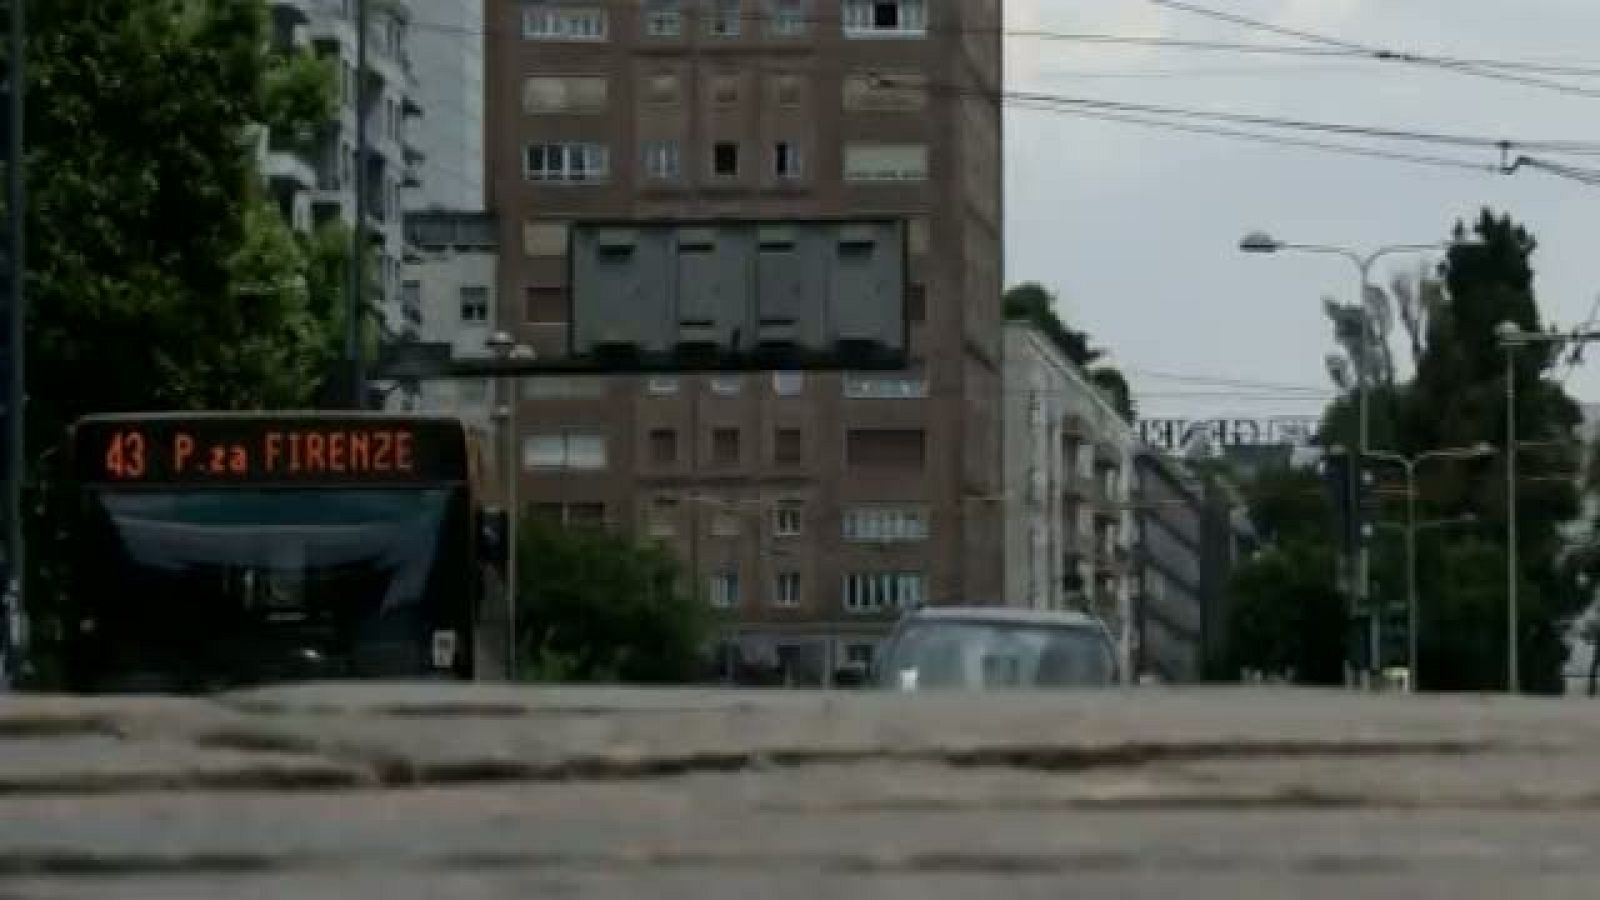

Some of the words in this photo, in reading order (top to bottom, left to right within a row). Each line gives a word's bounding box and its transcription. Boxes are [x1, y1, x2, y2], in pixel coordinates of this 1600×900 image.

[105, 431, 147, 478] 43
[174, 433, 249, 474] P.za
[264, 430, 415, 472] FIRENZE
